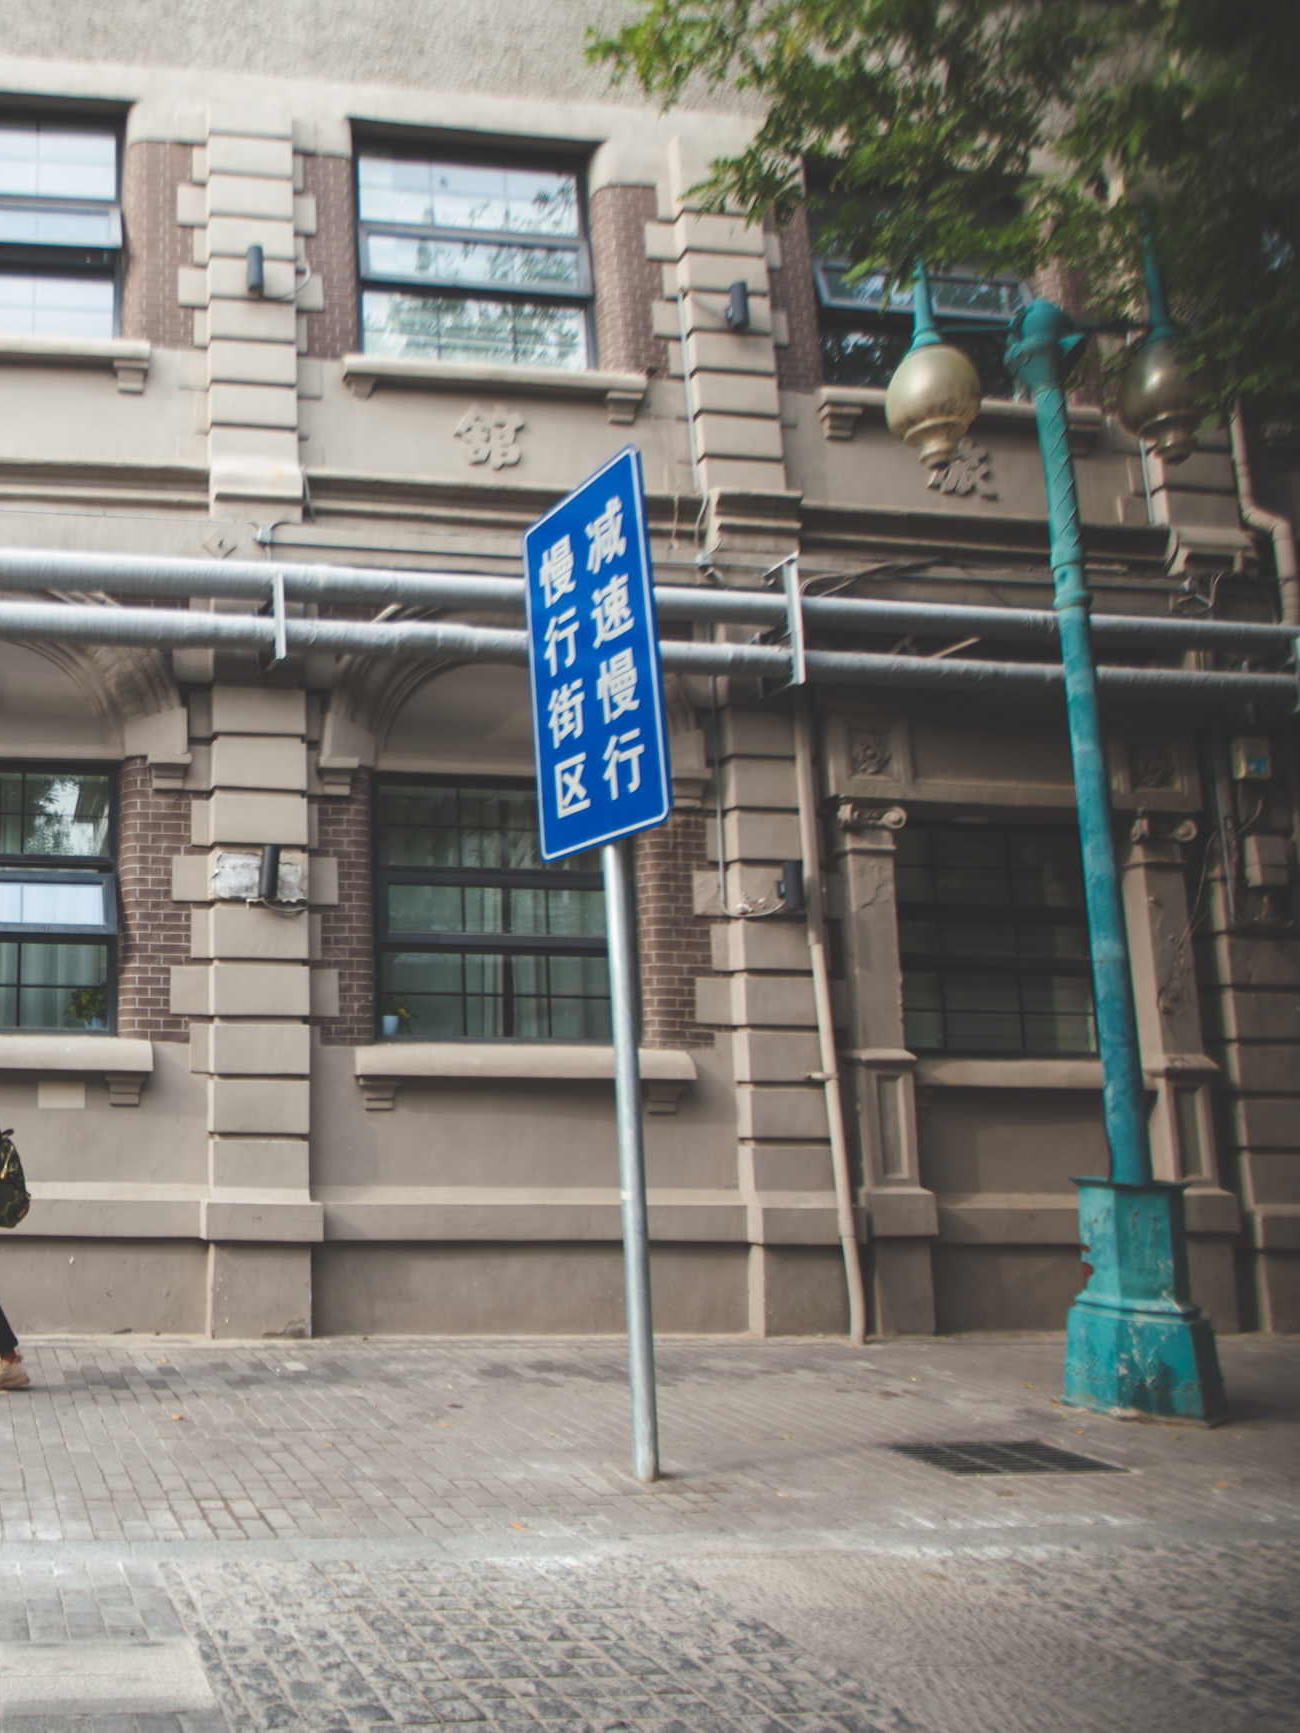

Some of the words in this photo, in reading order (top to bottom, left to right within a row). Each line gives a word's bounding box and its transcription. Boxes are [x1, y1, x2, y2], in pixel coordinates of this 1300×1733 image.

[539, 534, 591, 819] 慢行街区
[585, 495, 645, 801] 减速慢行
